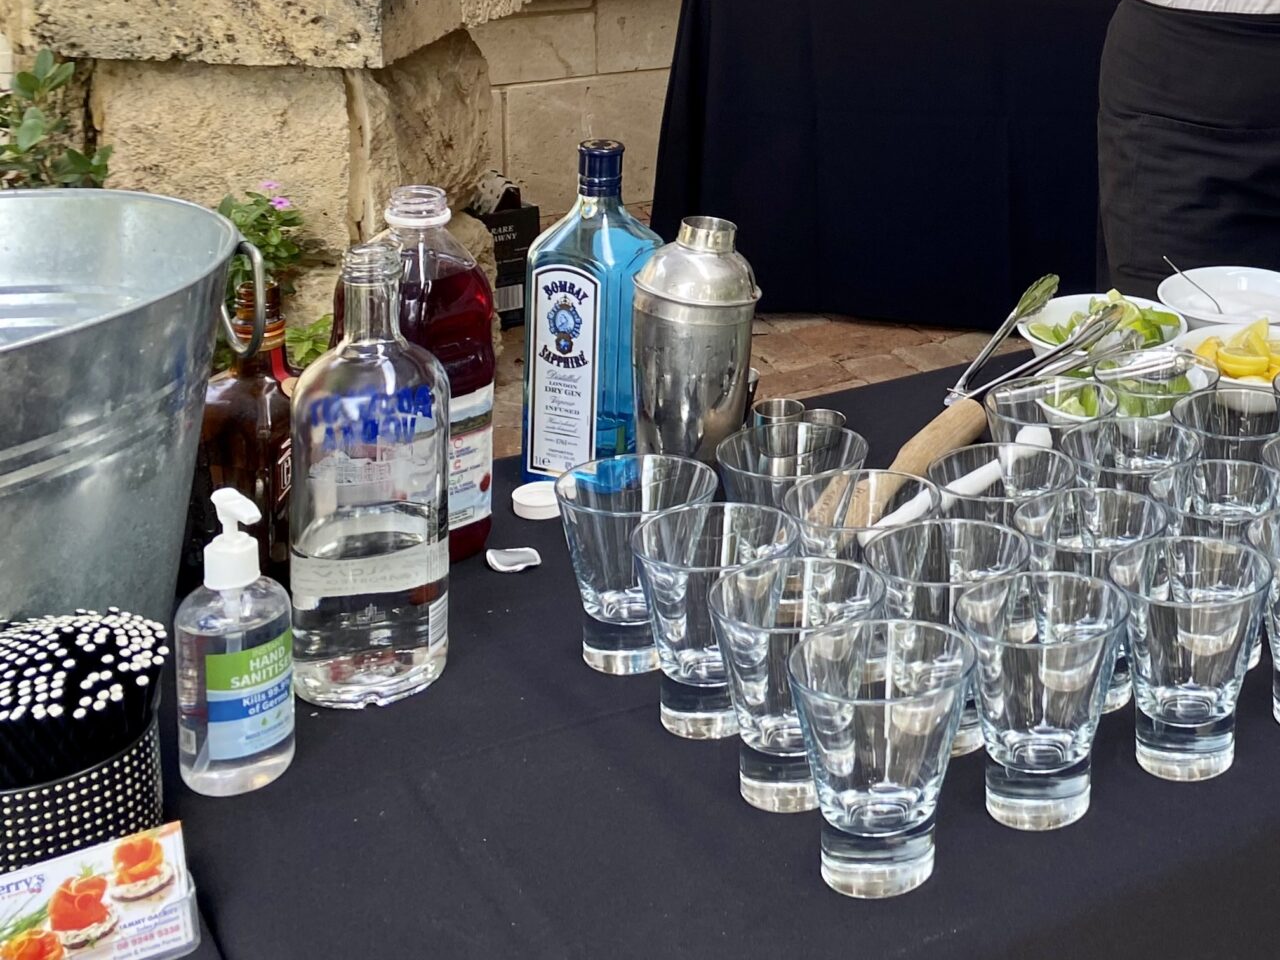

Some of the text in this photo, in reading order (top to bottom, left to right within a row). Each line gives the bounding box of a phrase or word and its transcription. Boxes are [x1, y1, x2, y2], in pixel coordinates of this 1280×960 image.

[542, 280, 589, 305] BOMBAY
[538, 344, 589, 369] SAPPHIRE
[544, 386, 582, 398] DRY GIN
[548, 381, 577, 389] LONDON
[545, 405, 580, 415] INFUSED
[249, 646, 285, 671] HAND
[242, 689, 266, 707] Kills
[248, 702, 260, 715] of
